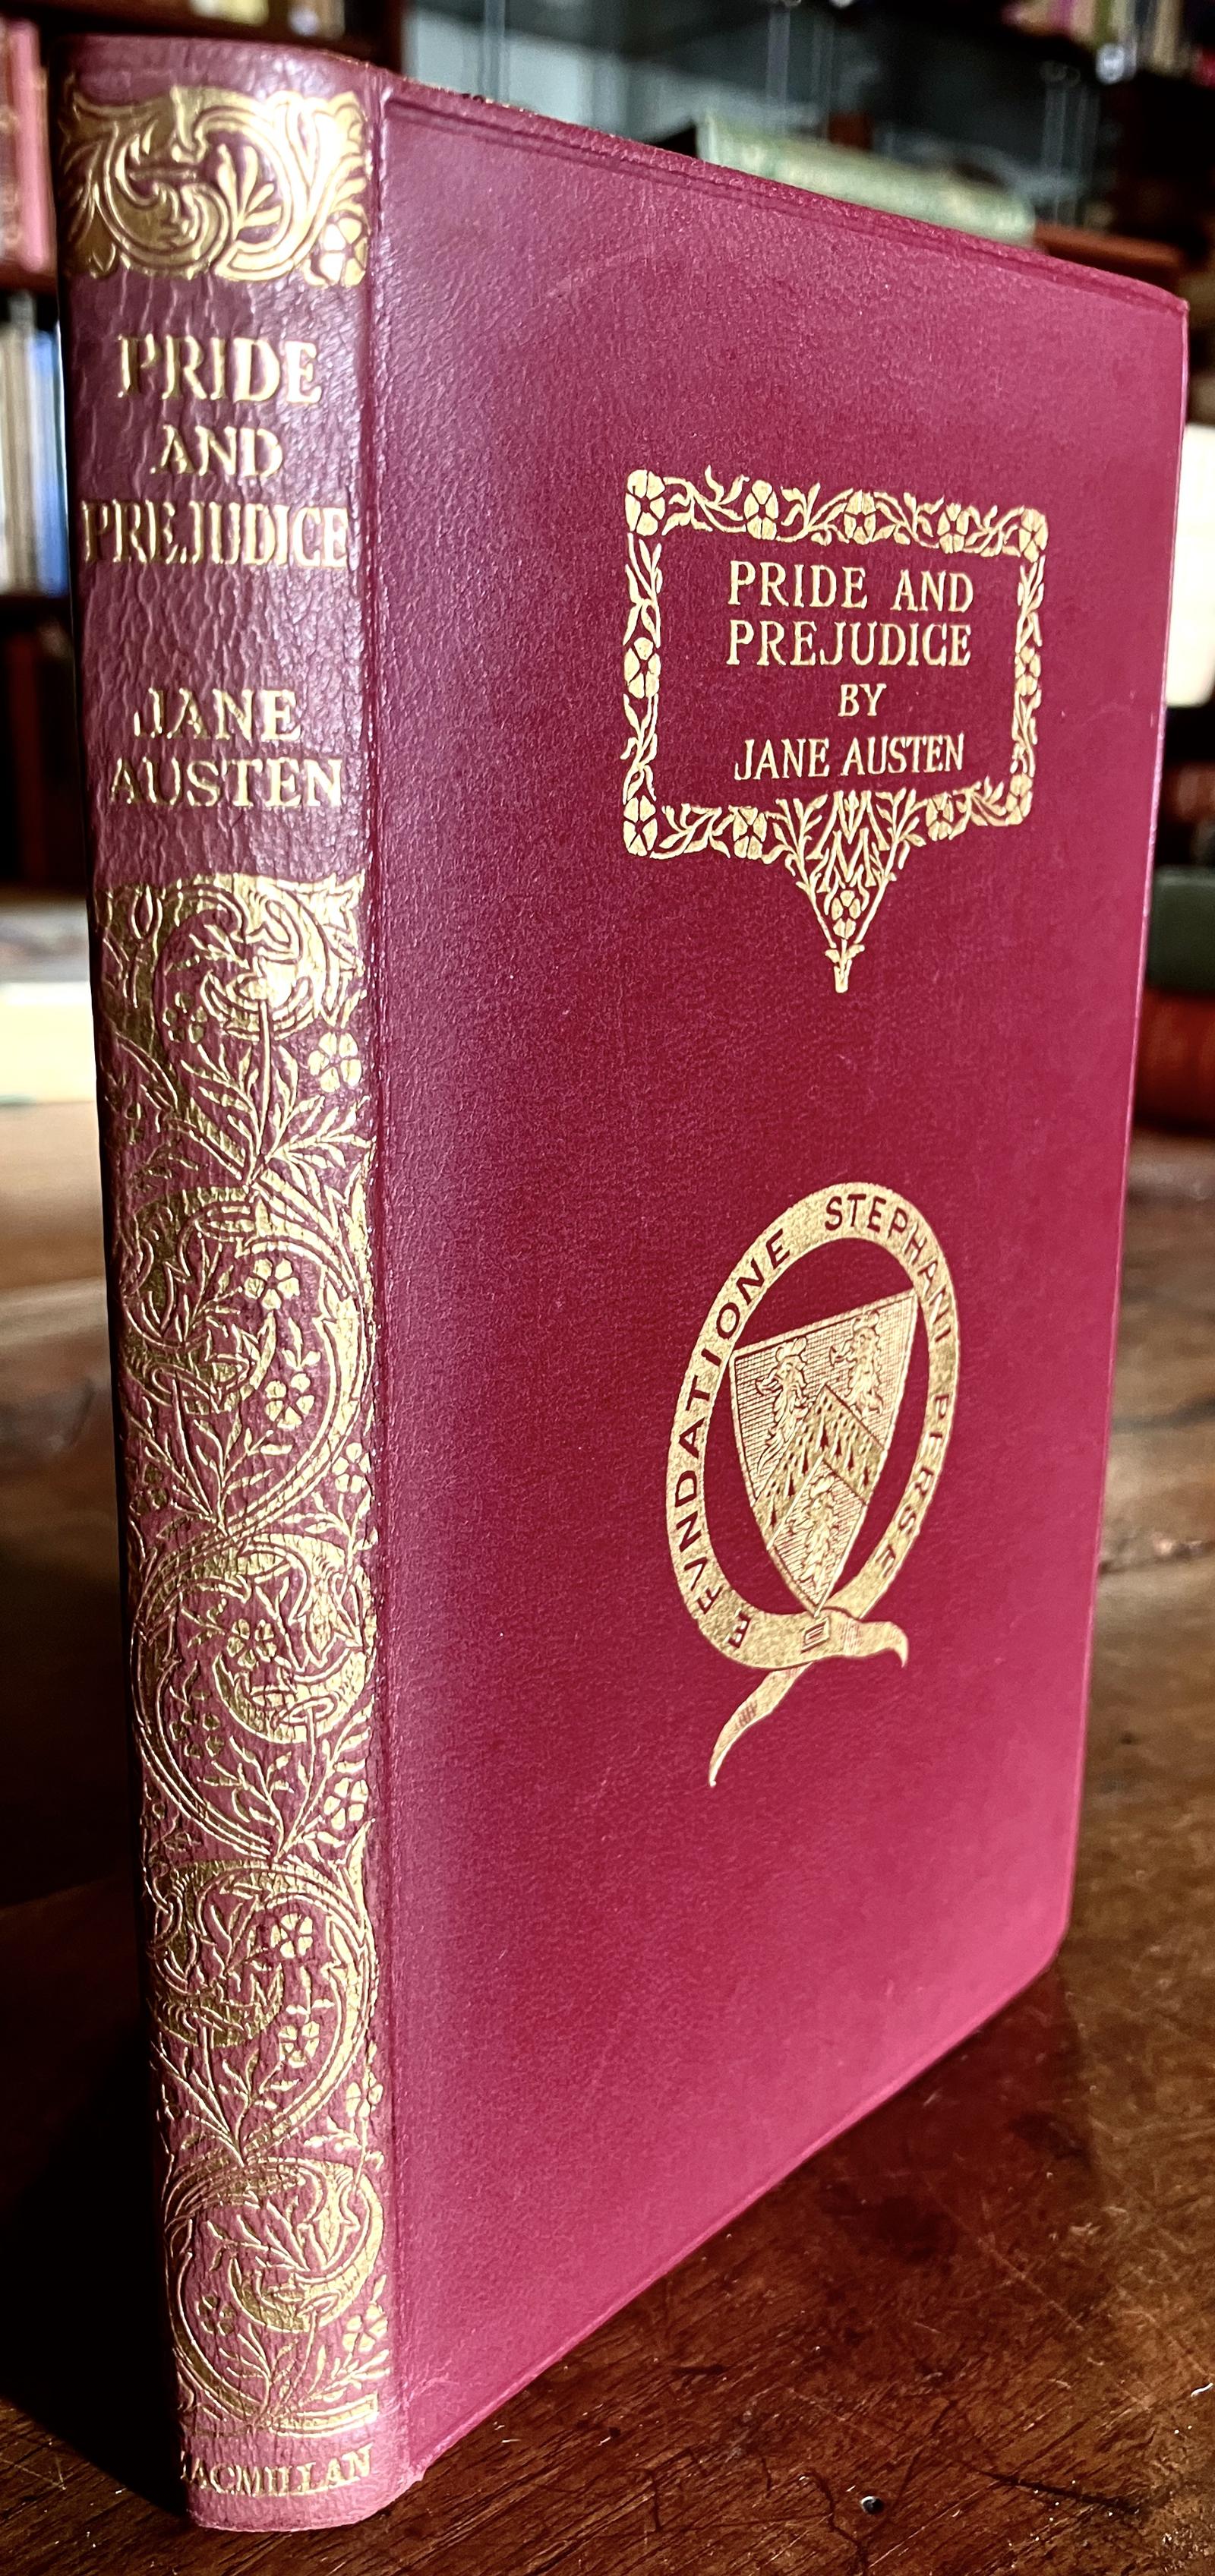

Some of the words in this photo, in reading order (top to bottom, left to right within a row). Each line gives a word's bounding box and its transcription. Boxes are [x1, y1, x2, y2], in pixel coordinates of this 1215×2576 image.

[118, 333, 322, 404] PRIDE
[150, 423, 284, 479] AND
[81, 498, 350, 568] PREJUDICE
[727, 560, 867, 609] PRIDE
[890, 569, 974, 612] AND
[726, 619, 971, 667] PREJUDICE
[133, 687, 302, 741] JANE
[838, 683, 887, 717] BY
[110, 756, 343, 808] AUSTEN
[734, 737, 830, 781] JANE
[840, 732, 964, 776] AUSTEN
[825, 1193, 953, 1344] STEPHANI
[674, 1229, 790, 1615] FVNDATIONE
[875, 1393, 951, 1578] PERSE
[727, 1611, 753, 1649] E
